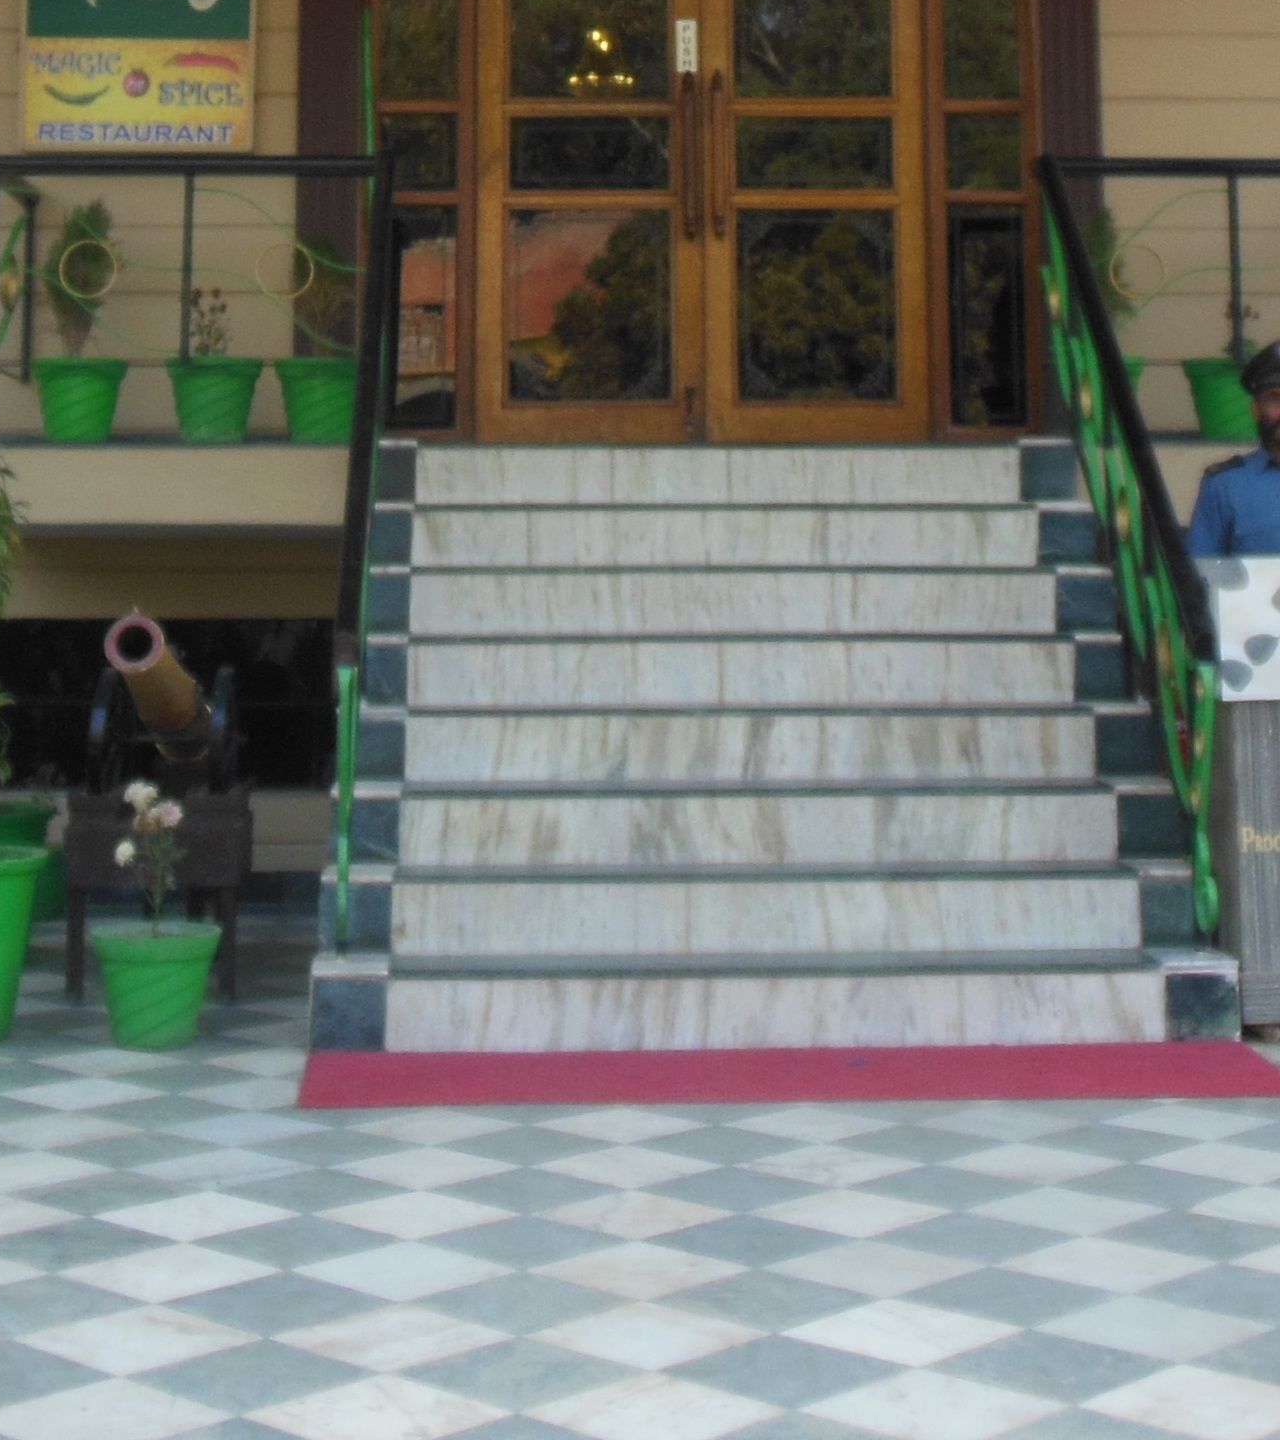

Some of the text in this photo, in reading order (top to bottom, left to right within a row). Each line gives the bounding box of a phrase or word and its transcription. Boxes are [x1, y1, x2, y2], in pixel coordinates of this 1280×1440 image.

[681, 22, 693, 69] PUSH
[159, 78, 245, 107] SPICE
[38, 122, 235, 144] RESTAURANT
